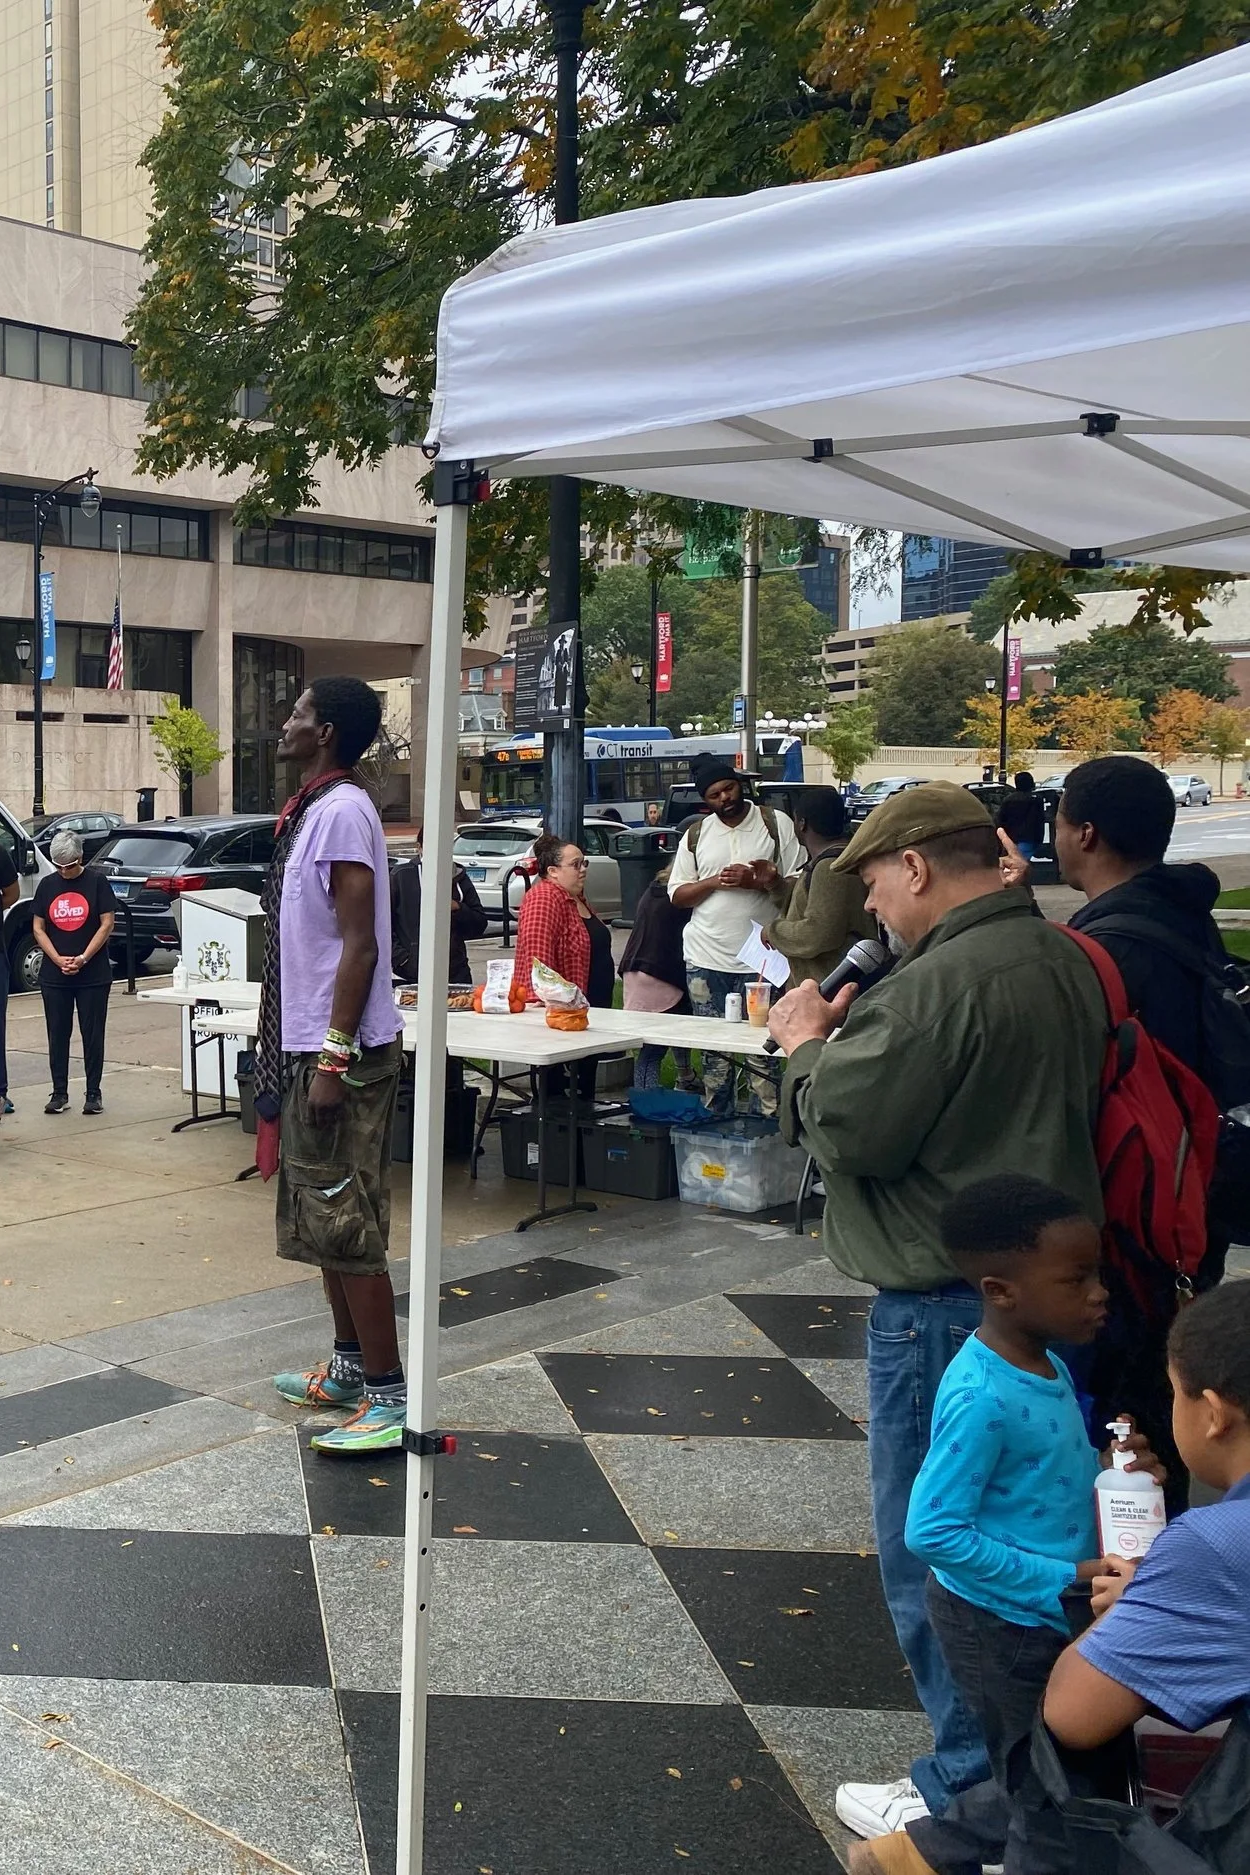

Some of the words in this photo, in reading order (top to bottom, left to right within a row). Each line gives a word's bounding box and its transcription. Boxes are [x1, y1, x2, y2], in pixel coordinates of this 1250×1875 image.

[41, 577, 50, 638] HARTFORD
[658, 617, 666, 661] HARTFORD
[12, 751, 94, 764] DITRICT
[58, 899, 70, 909] BE
[53, 906, 84, 918] LOVED
[193, 1006, 234, 1016] OFFICA
